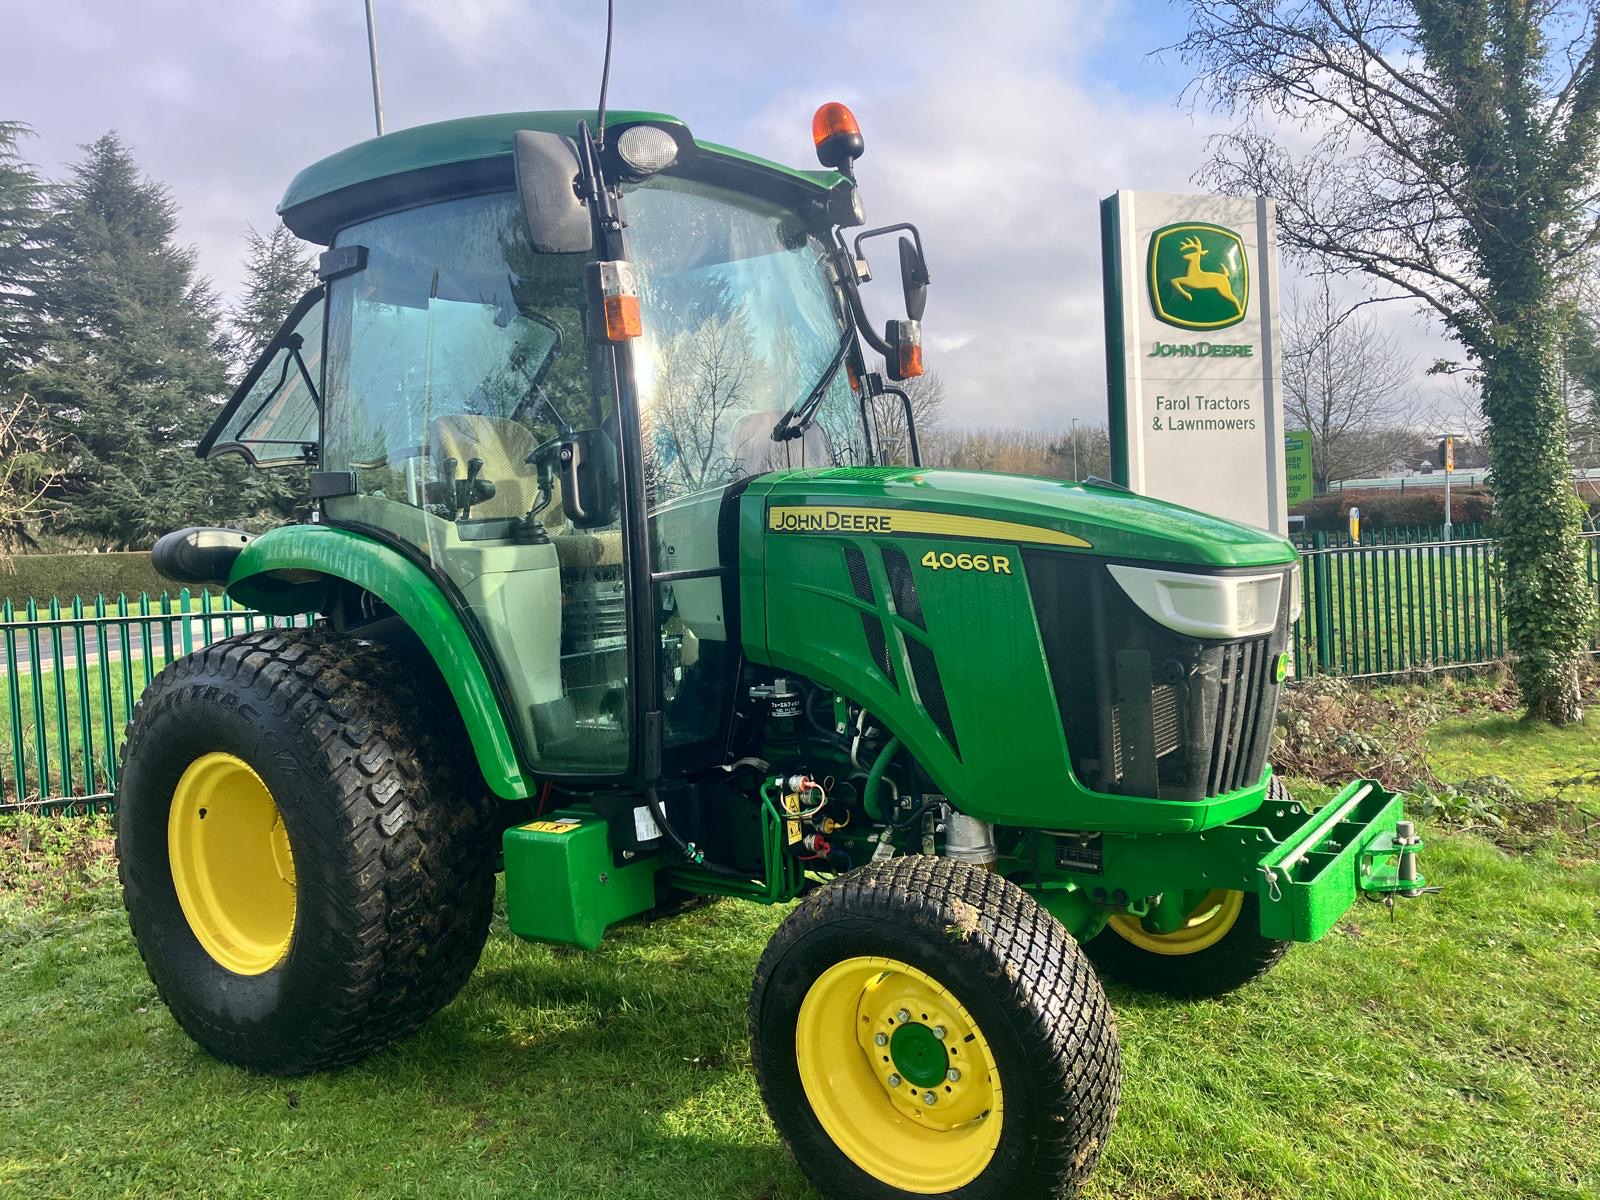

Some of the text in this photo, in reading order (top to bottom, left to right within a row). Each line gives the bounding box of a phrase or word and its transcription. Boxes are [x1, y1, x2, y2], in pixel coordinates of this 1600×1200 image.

[1147, 341, 1253, 358] JOHN DEERE
[1156, 395, 1250, 411] Farol Tractors
[1152, 416, 1256, 431] & Lawnmowers
[775, 511, 892, 532] JOHN DEERE
[921, 551, 1012, 575] 4066R
